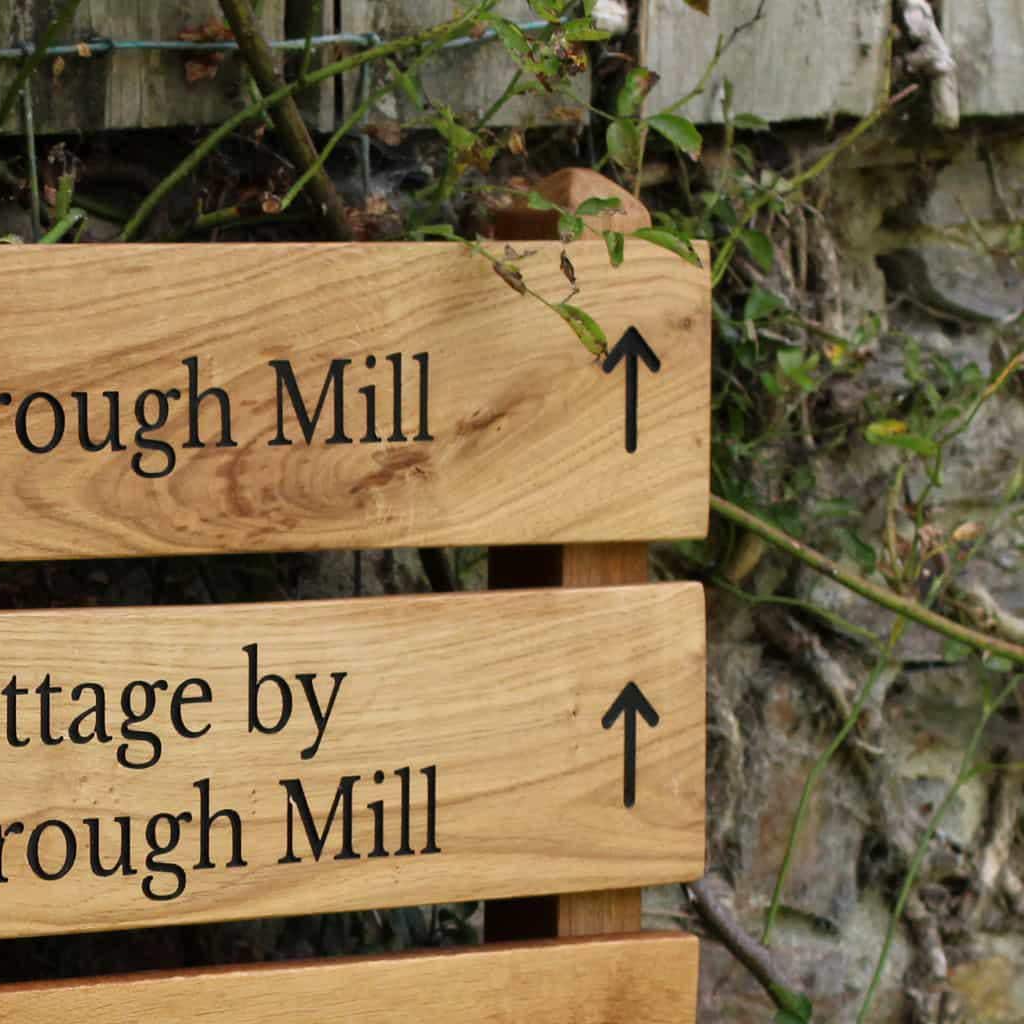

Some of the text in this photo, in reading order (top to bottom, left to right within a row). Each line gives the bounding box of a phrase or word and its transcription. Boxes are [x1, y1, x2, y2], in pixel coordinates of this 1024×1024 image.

[268, 352, 434, 446] Mill
[242, 644, 348, 760] by
[277, 765, 441, 865] Mill
